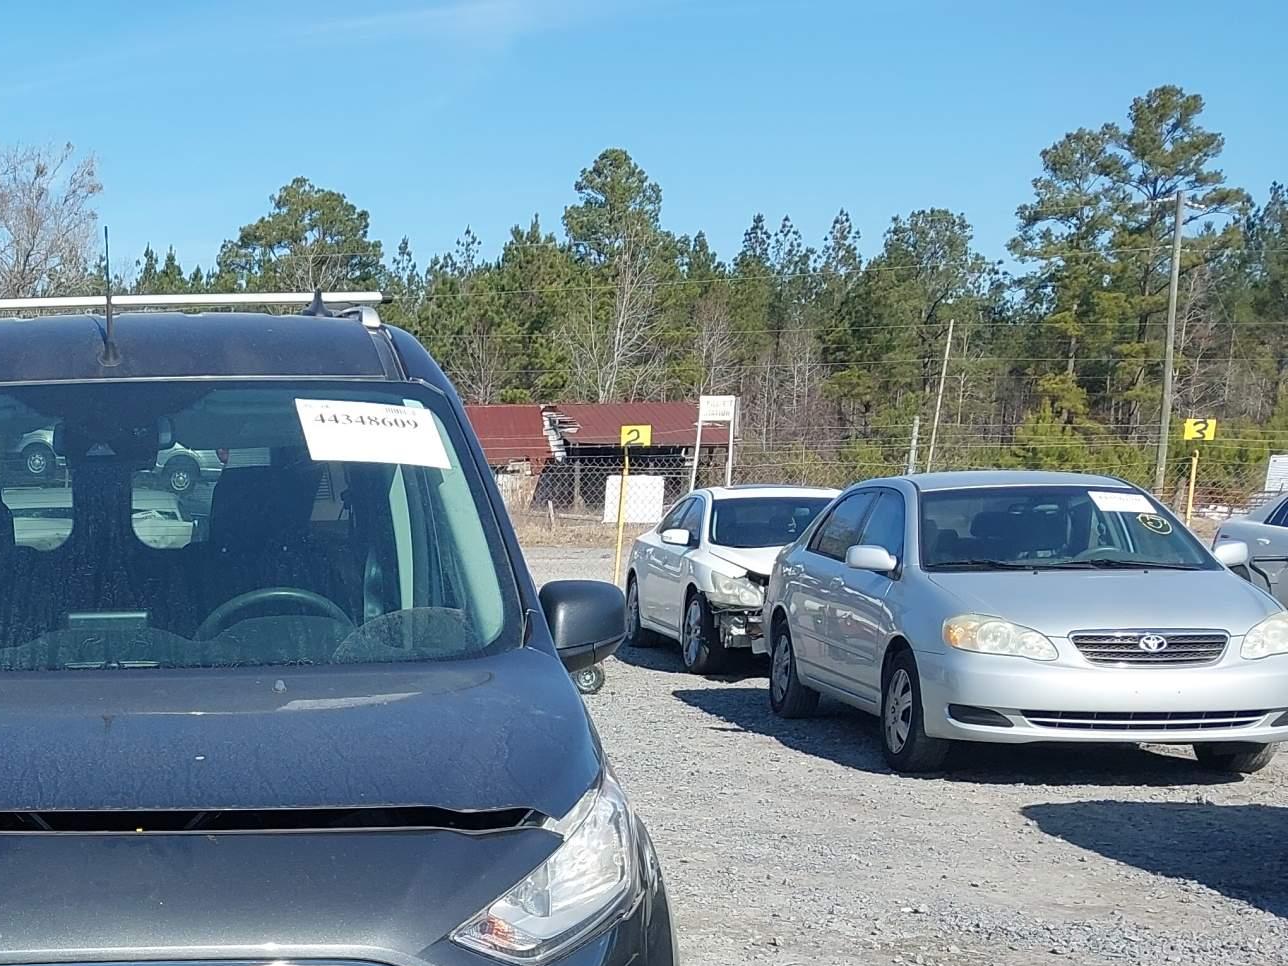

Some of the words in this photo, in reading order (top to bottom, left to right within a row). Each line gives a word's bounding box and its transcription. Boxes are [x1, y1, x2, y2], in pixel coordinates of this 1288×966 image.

[313, 413, 419, 429] 44348609
[1192, 420, 1209, 439] 3
[624, 429, 644, 446] 2
